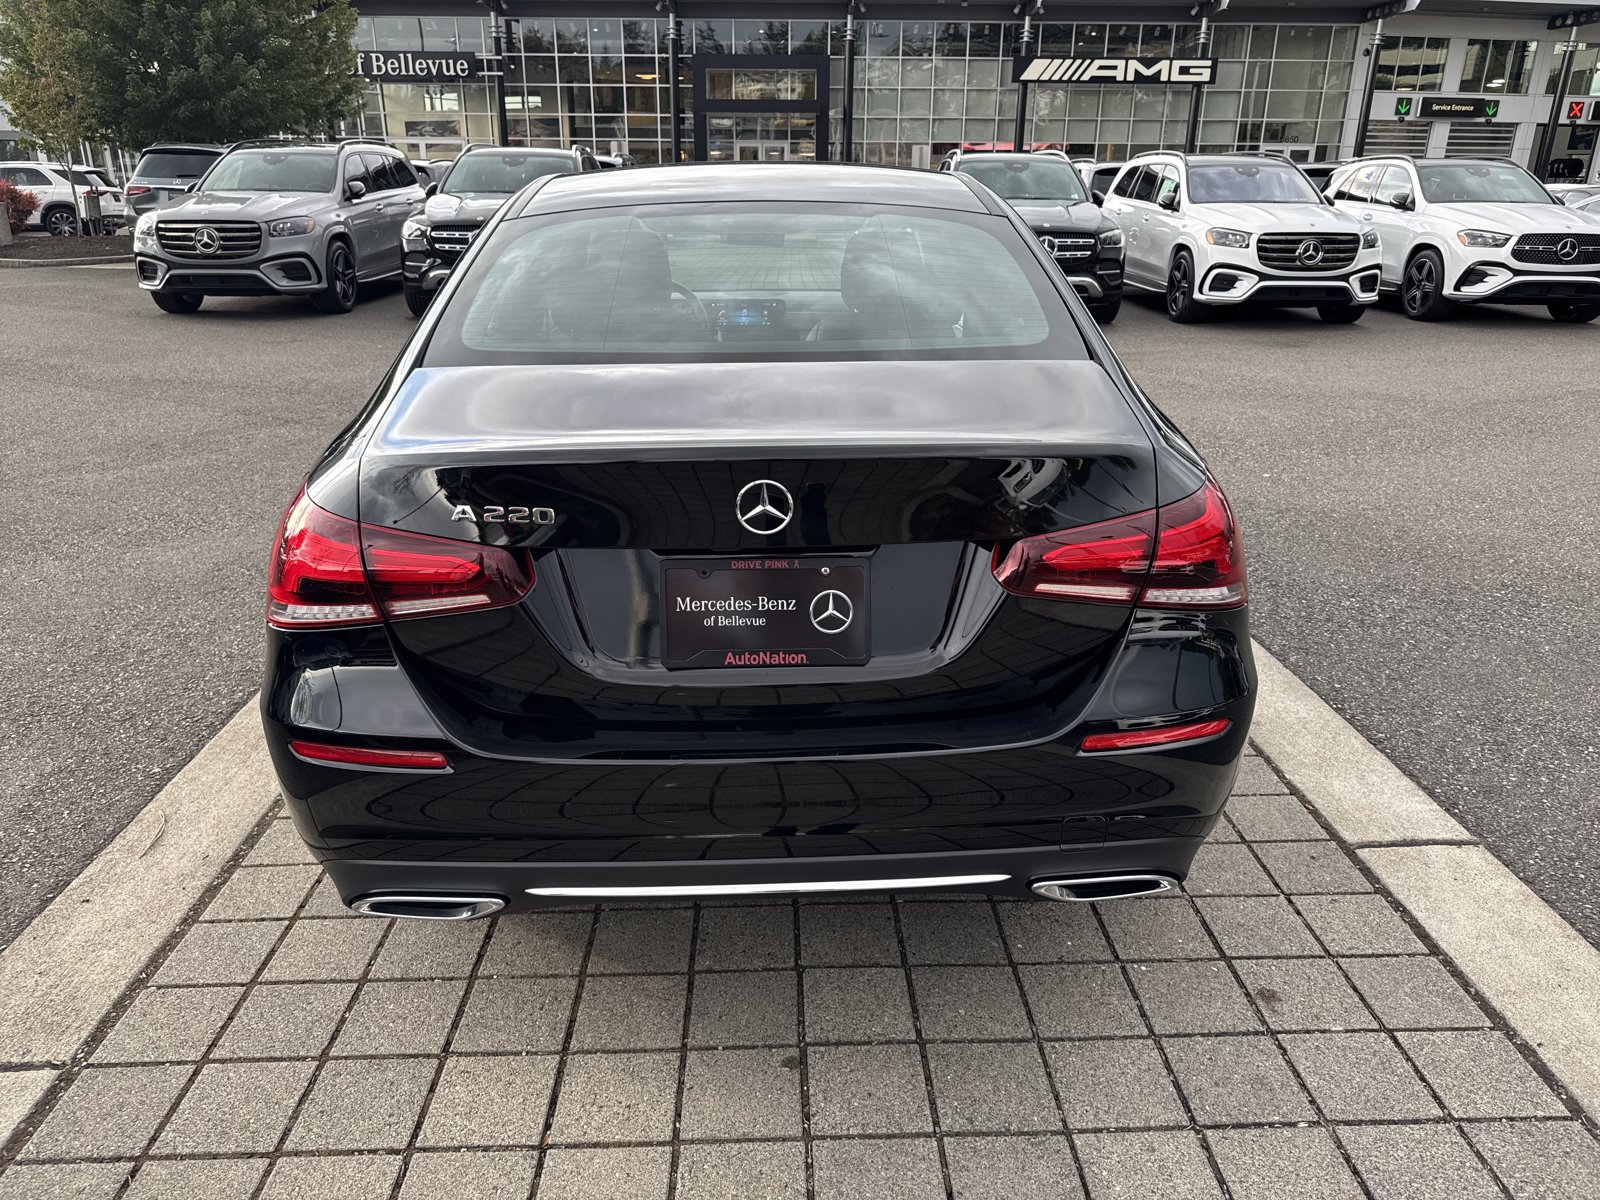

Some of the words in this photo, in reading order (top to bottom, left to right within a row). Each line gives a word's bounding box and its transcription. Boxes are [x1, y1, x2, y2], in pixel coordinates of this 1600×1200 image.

[370, 53, 469, 76] Bellevue
[1432, 103, 1451, 111] Service
[450, 504, 477, 522] A
[483, 505, 556, 525] 220
[731, 560, 762, 569] DRIVE
[764, 560, 789, 569] PINK
[675, 596, 797, 612] Mercedes-Benz
[703, 615, 716, 627] of
[718, 614, 766, 626] Bellevue
[724, 651, 807, 665] AutoNation
